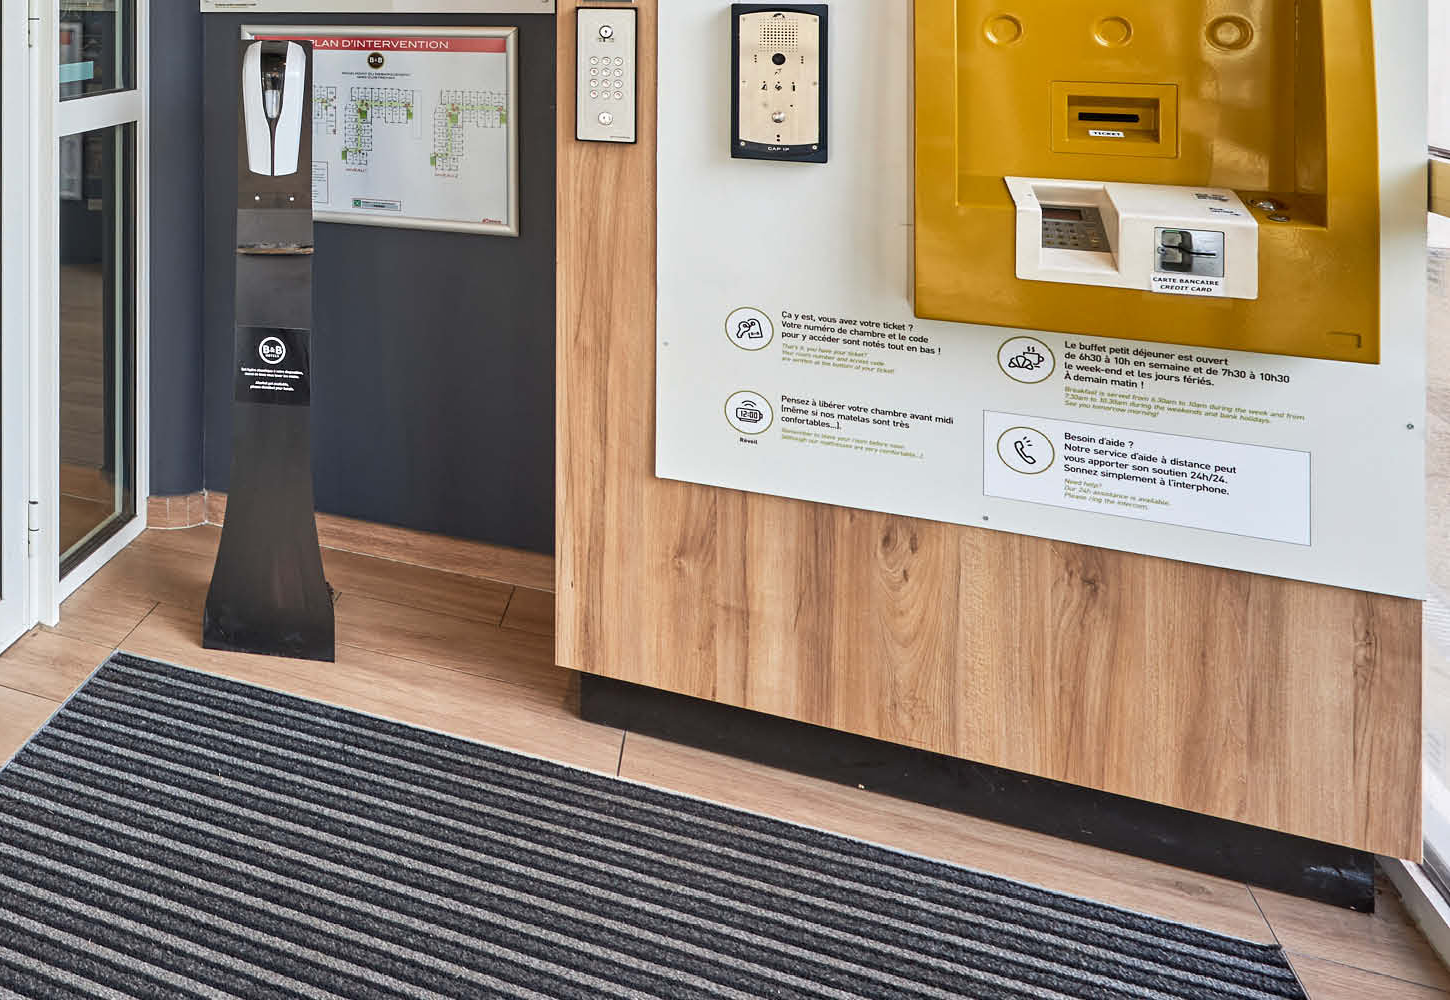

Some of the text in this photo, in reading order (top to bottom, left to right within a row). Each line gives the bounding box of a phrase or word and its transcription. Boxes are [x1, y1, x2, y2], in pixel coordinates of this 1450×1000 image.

[342, 40, 449, 49] D'INTERVENTION
[1179, 278, 1219, 286] BANCAIRE
[781, 310, 914, 332] Ça y est, vous avez votre ticket ?
[263, 345, 282, 354] B&B
[1064, 432, 1134, 449] Besoin d'aide ?
[1063, 442, 1236, 474] Notre service d'aide à distance peut
[1063, 455, 1228, 484] vous apporter son soutien 24h/24.
[1063, 463, 1229, 495] Sonnez simplement à l'interphone.
